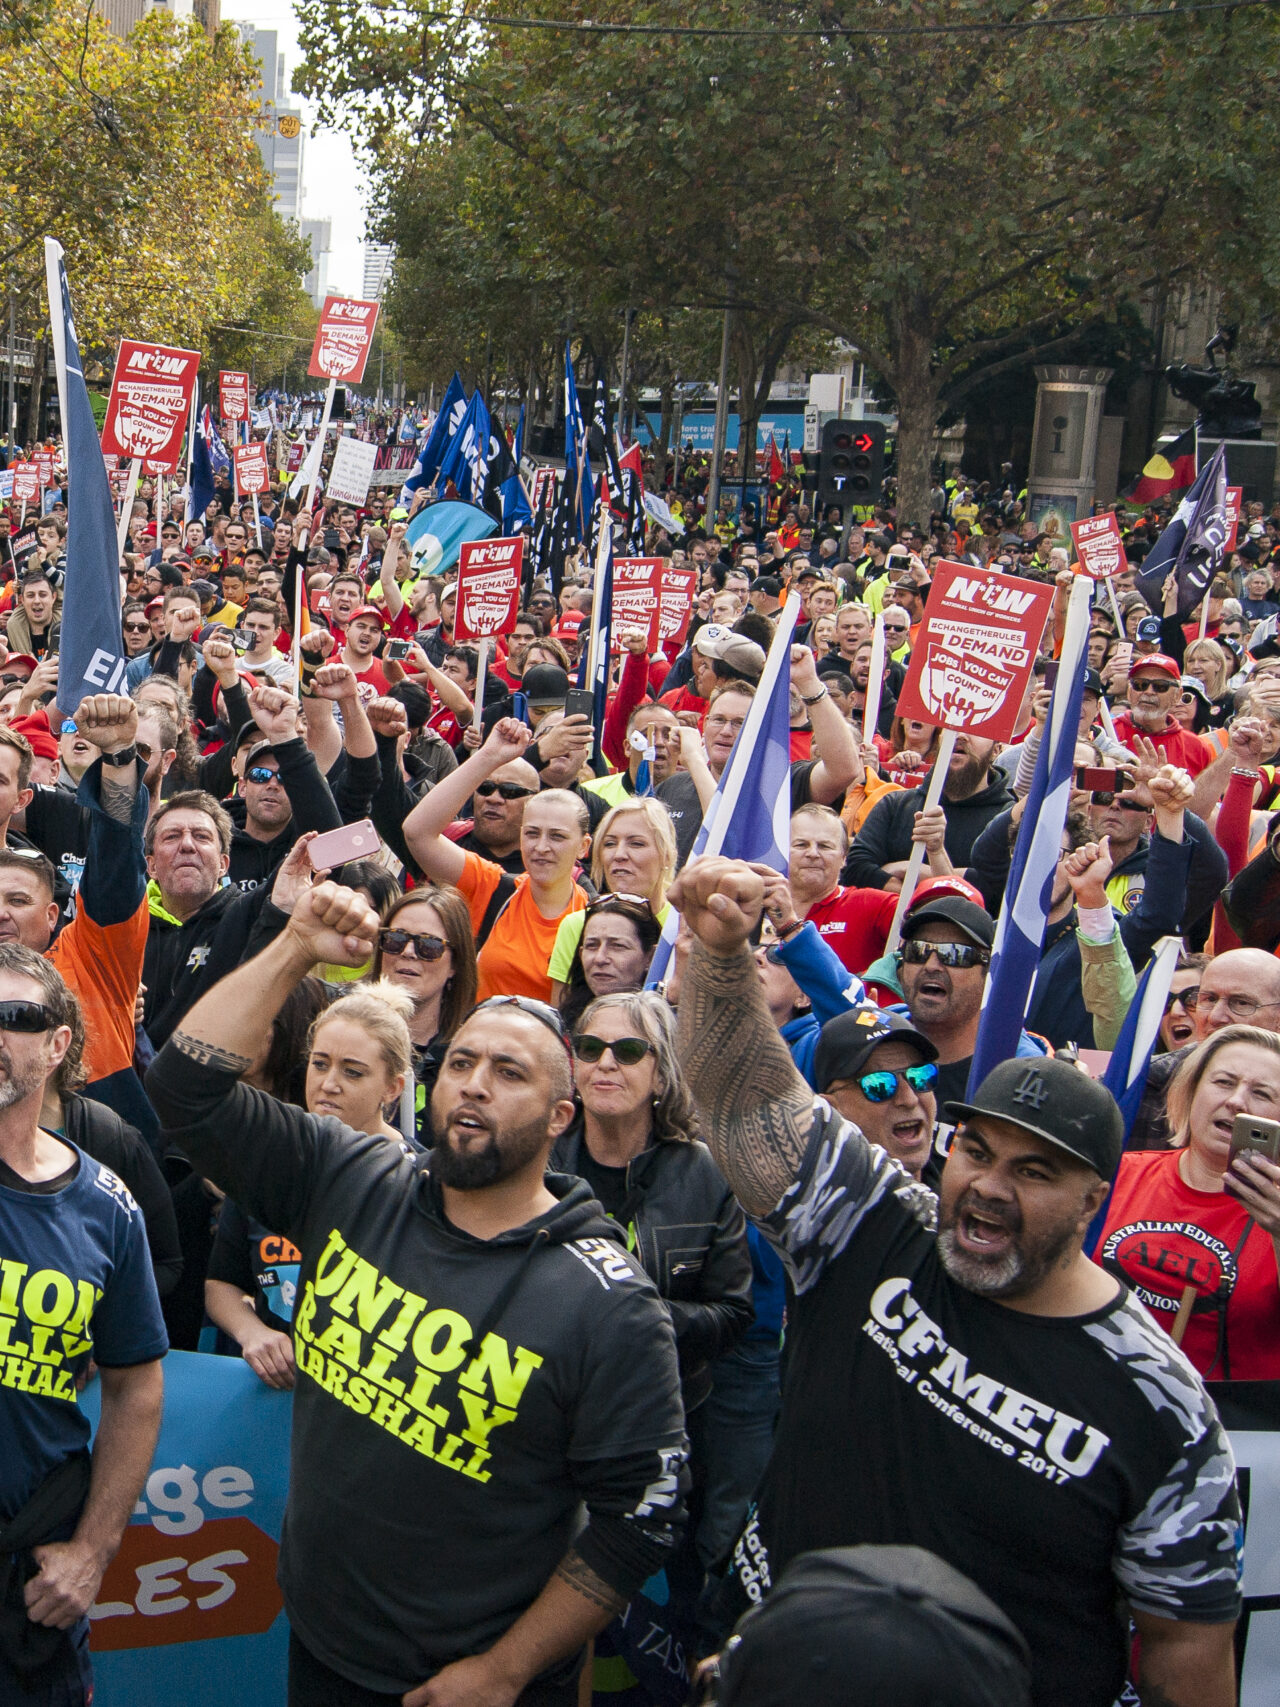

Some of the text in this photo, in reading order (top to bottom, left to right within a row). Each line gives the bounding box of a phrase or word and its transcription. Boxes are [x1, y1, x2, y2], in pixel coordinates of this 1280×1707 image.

[282, 119, 297, 128] CUT
[282, 127, 296, 135] OFF
[331, 331, 366, 342] DEMAND
[1043, 367, 1106, 381] INFO
[120, 384, 181, 394] #CHANGETHERULES
[132, 393, 183, 408] DEMAND
[133, 420, 155, 431] COUNT
[143, 409, 158, 419] YOU
[160, 416, 174, 426] CAN
[1088, 537, 1118, 550] DEMAND
[475, 579, 515, 591] DEMAND
[612, 599, 655, 607] DEMAND
[941, 600, 968, 611] NATIONAL
[968, 606, 986, 615] UNION
[931, 622, 1022, 642] #CHANGETHERULES
[948, 635, 1025, 661] DEMAND
[931, 653, 1009, 686] JOBS YOU CAN
[946, 674, 997, 700] COUNT ON
[866, 1029, 892, 1040] AMW
[1013, 1067, 1049, 1111] LA
[1103, 1221, 1184, 1260] AUSTRALIAN
[1120, 1241, 1217, 1285] AEU
[314, 1228, 543, 1409] UNION
[296, 1280, 518, 1450] RALLY
[870, 1277, 1111, 1478] CFMEU
[294, 1329, 492, 1484] MARSHALL
[917, 1380, 1016, 1457] Conference
[1018, 1450, 1070, 1486] 2017
[734, 1538, 762, 1605] ordo
